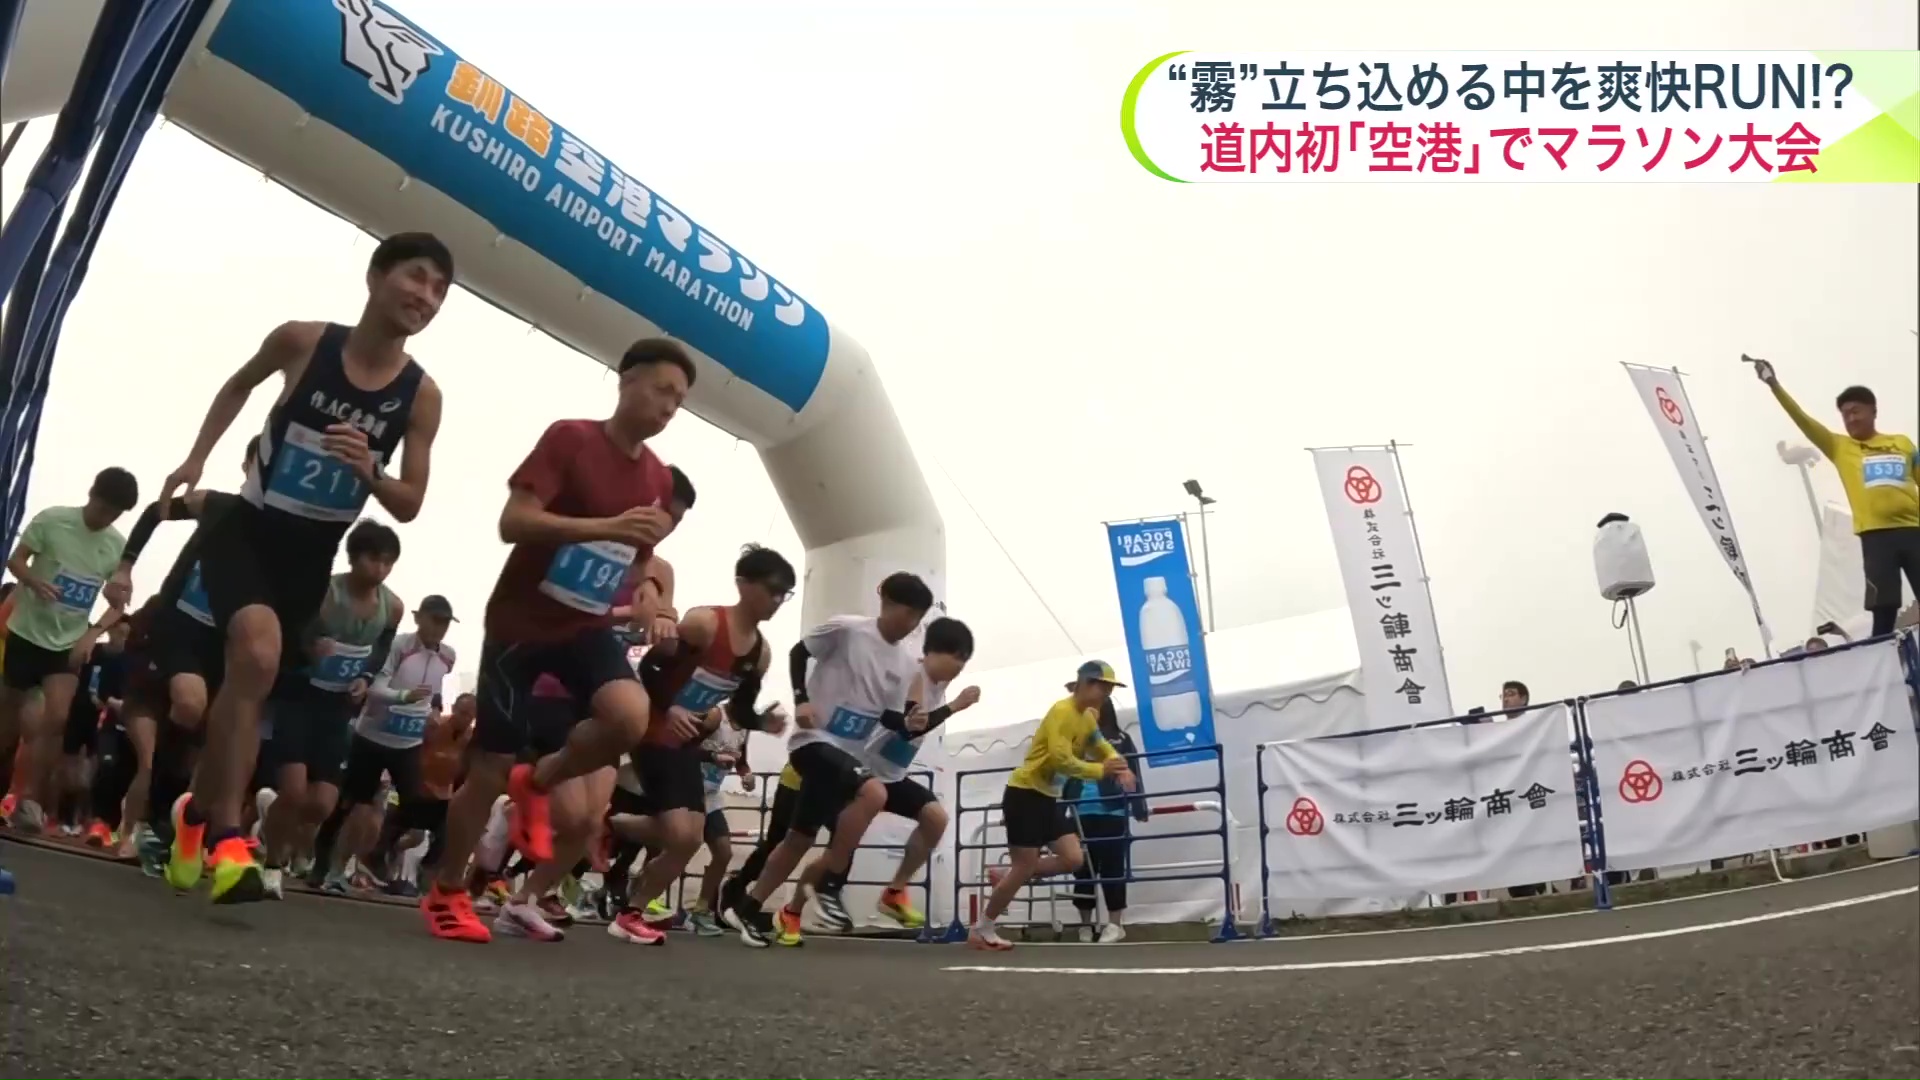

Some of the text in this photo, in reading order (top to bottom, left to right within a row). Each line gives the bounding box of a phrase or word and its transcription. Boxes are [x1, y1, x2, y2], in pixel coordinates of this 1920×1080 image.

[430, 104, 755, 331] KUSHIRO AIRPORT MARATHON
[578, 558, 624, 591] 194
